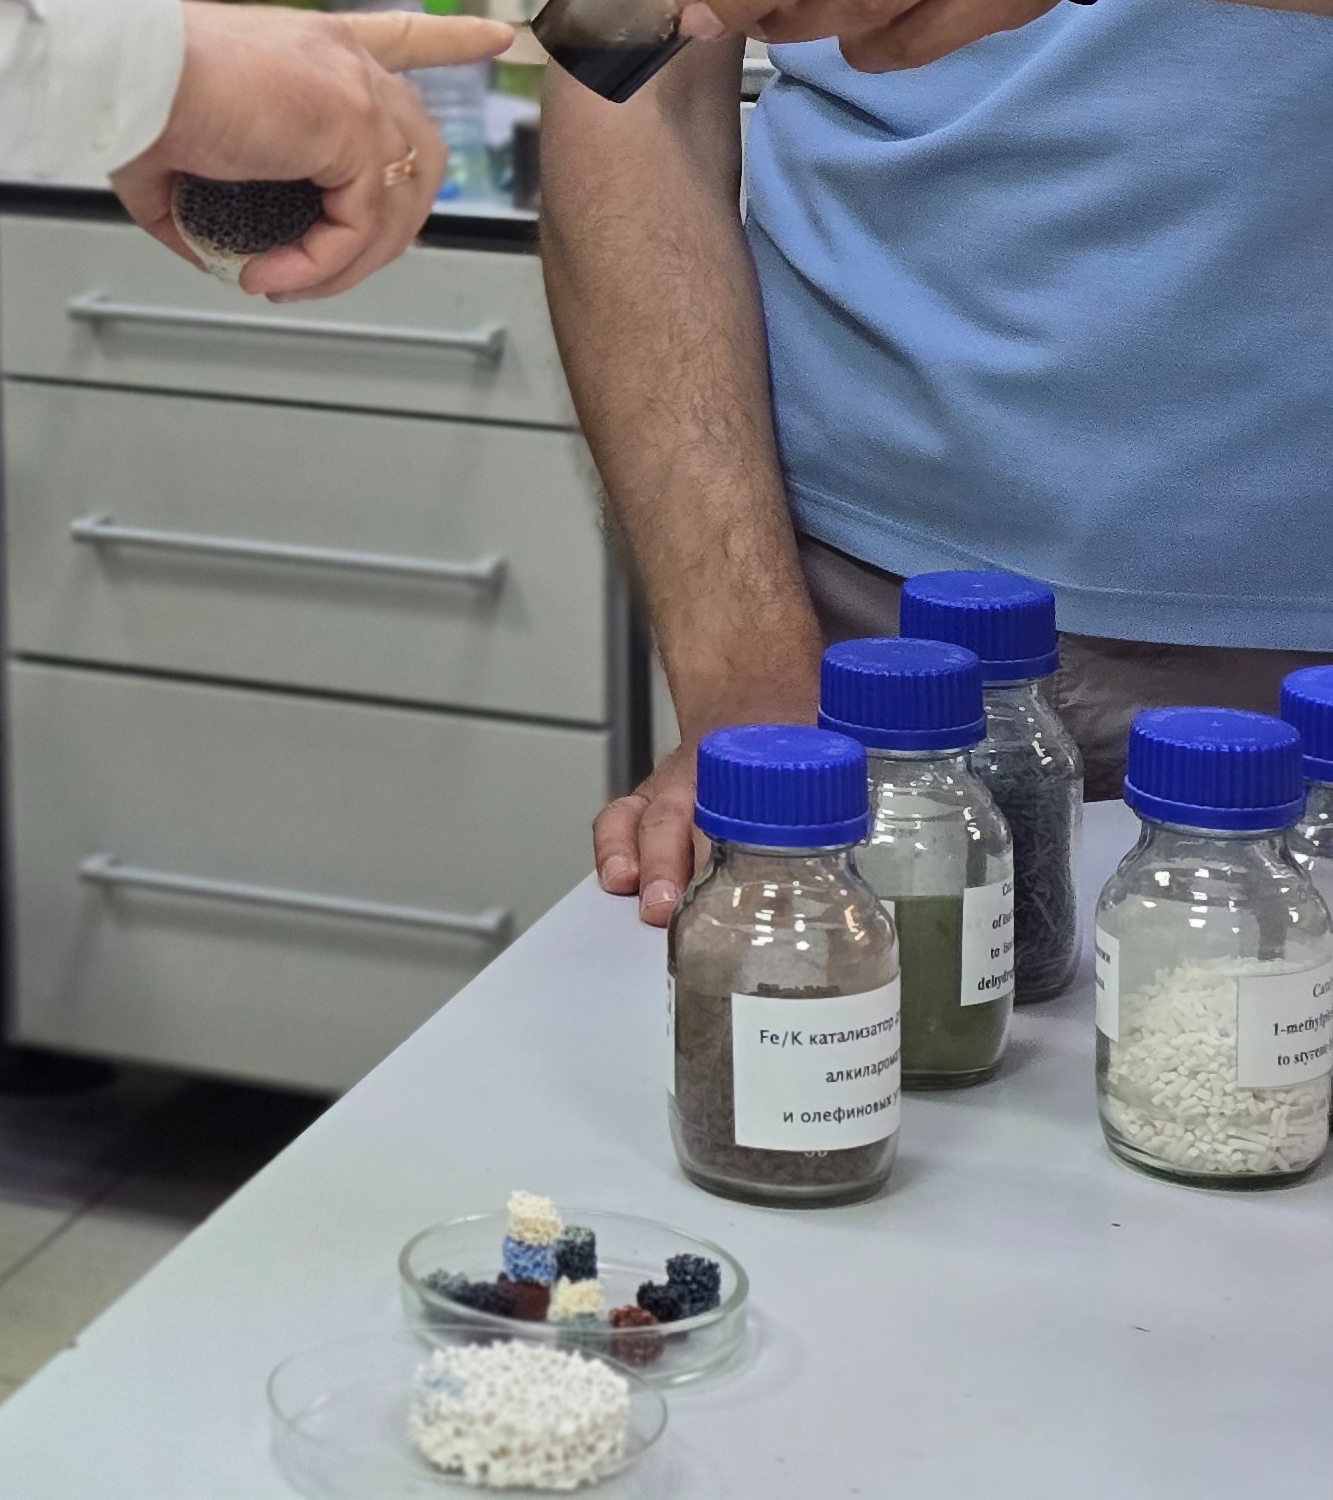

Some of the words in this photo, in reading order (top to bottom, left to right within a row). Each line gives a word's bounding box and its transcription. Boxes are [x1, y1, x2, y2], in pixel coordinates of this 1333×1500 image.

[990, 947, 1000, 960] to
[759, 1028, 803, 1049] Fe/K
[809, 1015, 894, 1046] катализатор
[1277, 1055, 1290, 1067] to
[783, 1110, 794, 1124] и
[800, 1094, 892, 1125] олефиновых
